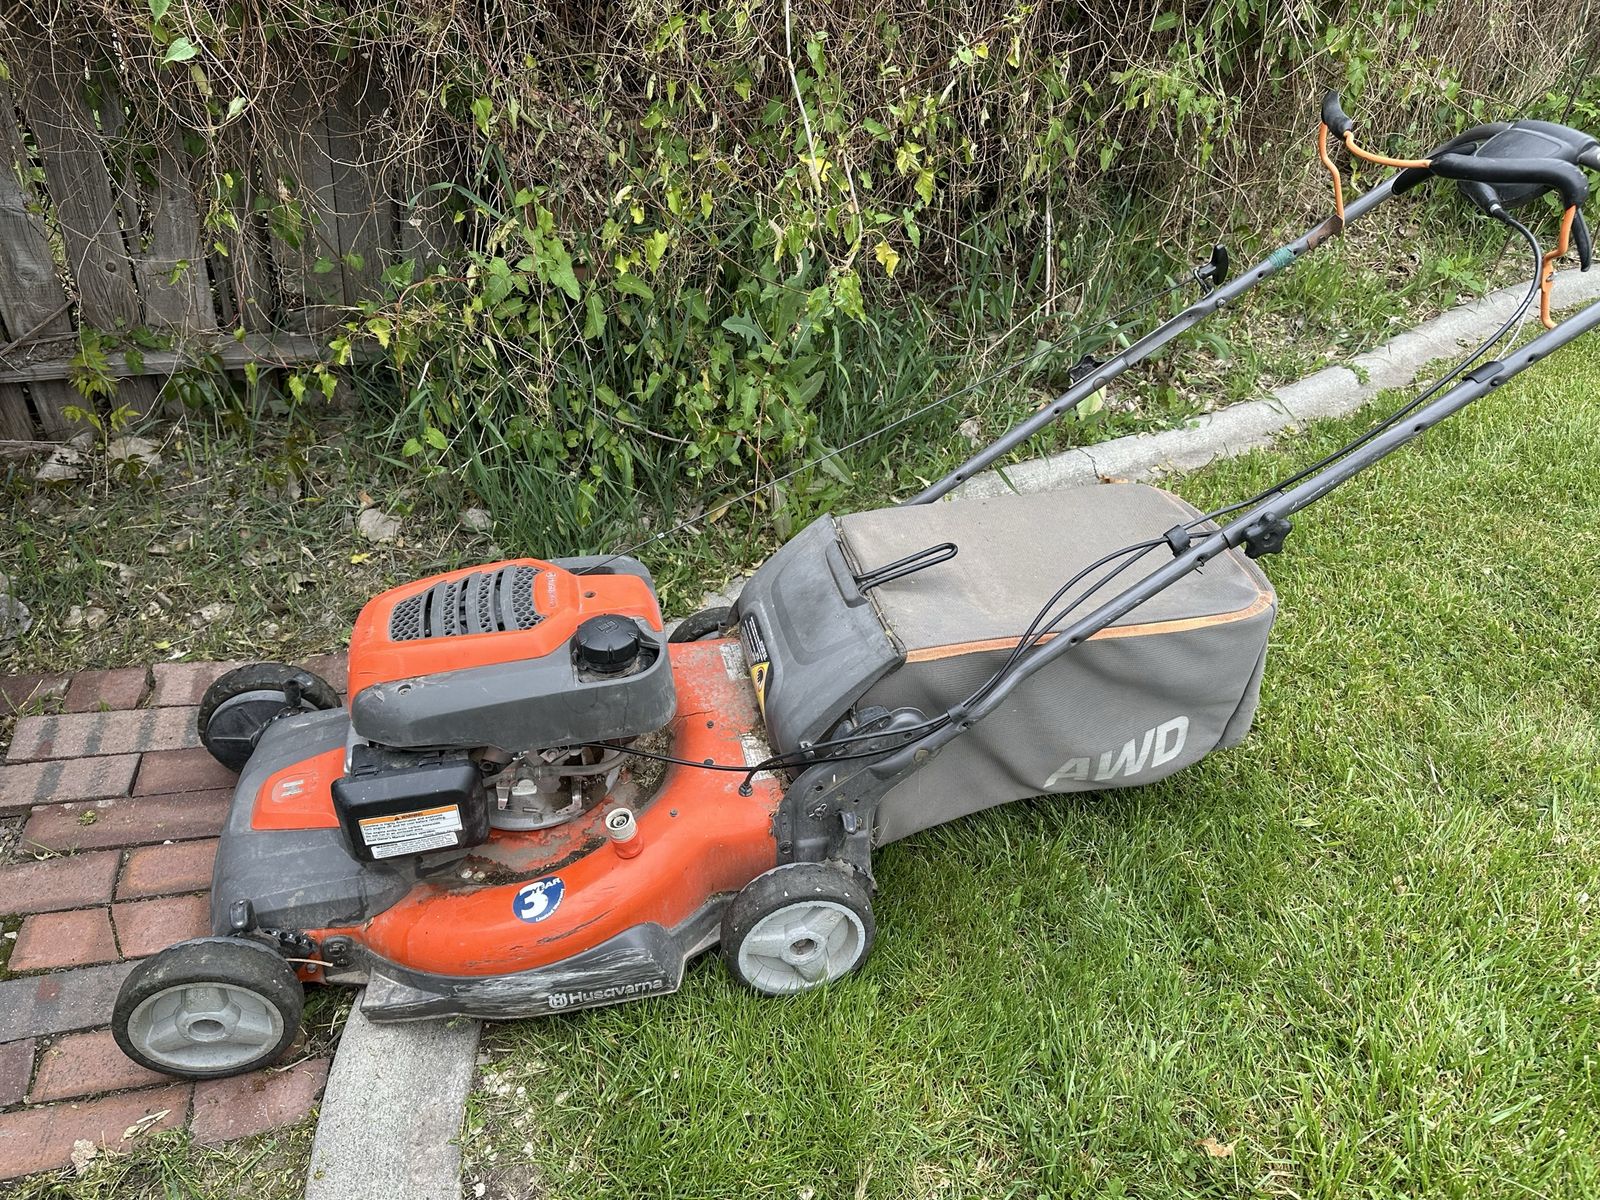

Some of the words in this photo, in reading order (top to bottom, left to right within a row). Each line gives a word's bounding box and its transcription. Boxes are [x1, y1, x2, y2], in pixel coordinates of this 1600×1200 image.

[1043, 715, 1189, 788] AWD
[519, 881, 549, 919] 3
[531, 877, 561, 894] YEAR
[569, 979, 663, 1004] Husqvarna
